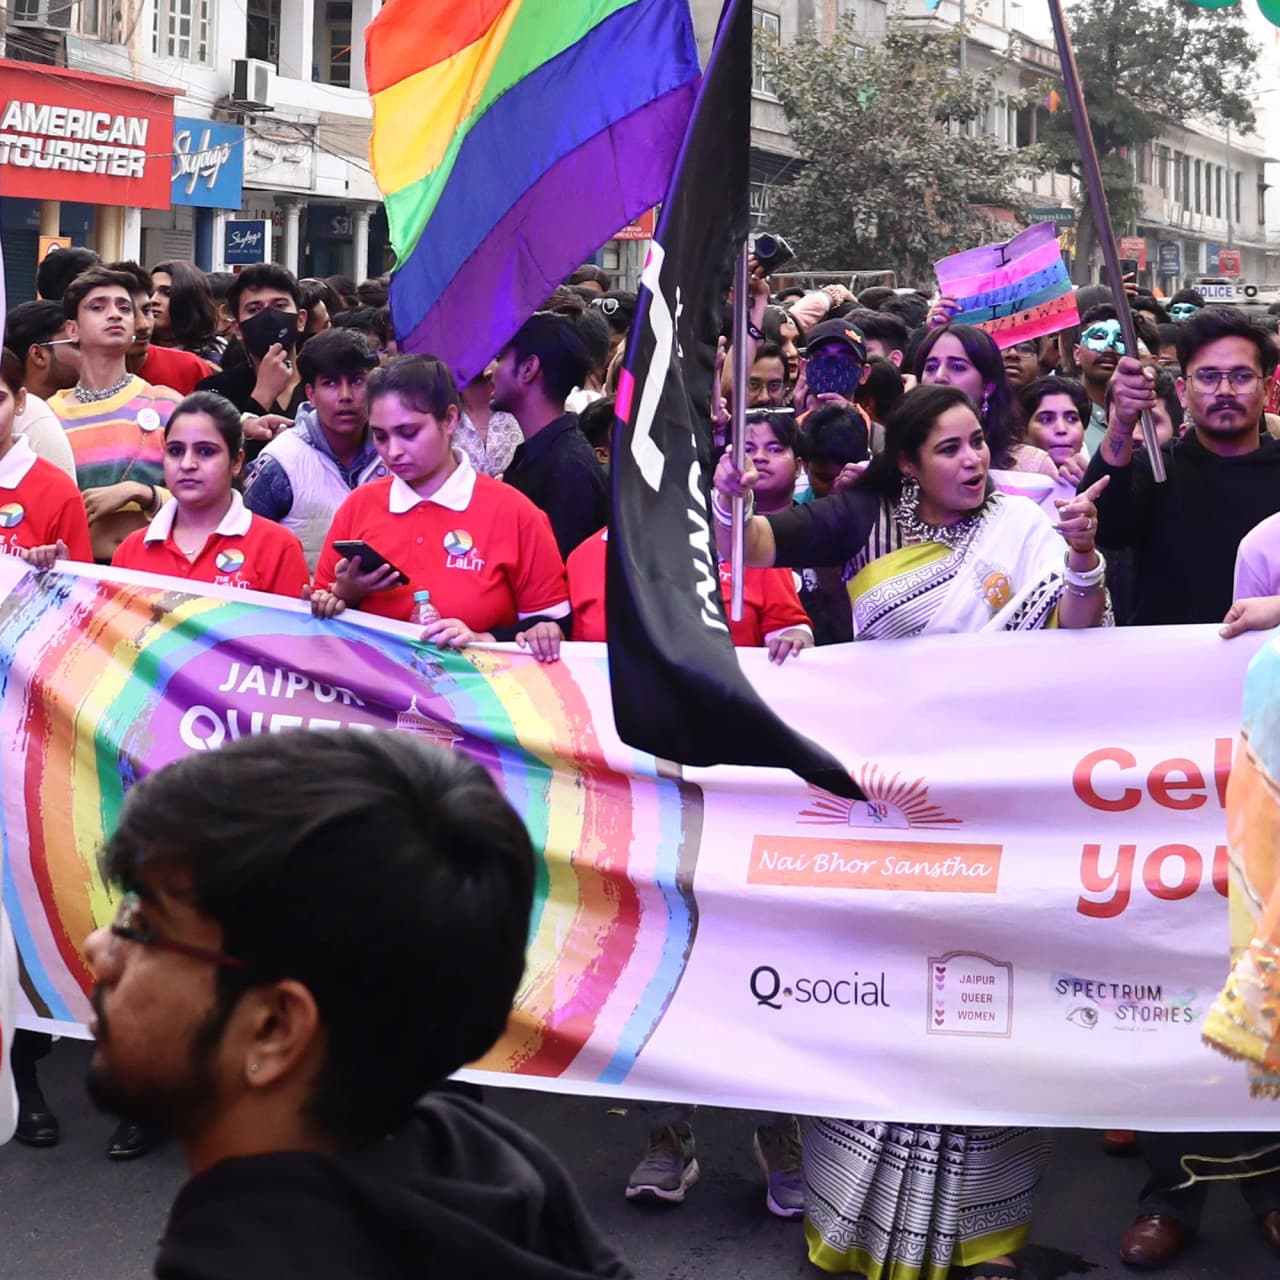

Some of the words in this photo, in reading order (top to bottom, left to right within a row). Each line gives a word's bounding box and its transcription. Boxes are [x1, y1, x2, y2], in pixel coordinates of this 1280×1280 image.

[0, 100, 149, 147] AMERICAN
[0, 133, 146, 179] TOURISTER
[171, 128, 231, 195] Skybags
[228, 229, 262, 249] Skybags
[994, 245, 1011, 268] I
[1194, 285, 1233, 298] POLICE
[446, 555, 485, 571] LaLIT
[218, 662, 366, 707] JAIPUR
[758, 849, 810, 871] Nai
[812, 851, 877, 874] Bhor
[880, 855, 993, 878] Sanstha
[959, 974, 996, 985] JAIPUR
[961, 992, 993, 1003] QUEER
[1055, 979, 1162, 1002] SPECTRUM
[957, 1009, 996, 1022] WOMEN
[1115, 1004, 1194, 1024] STORIES
